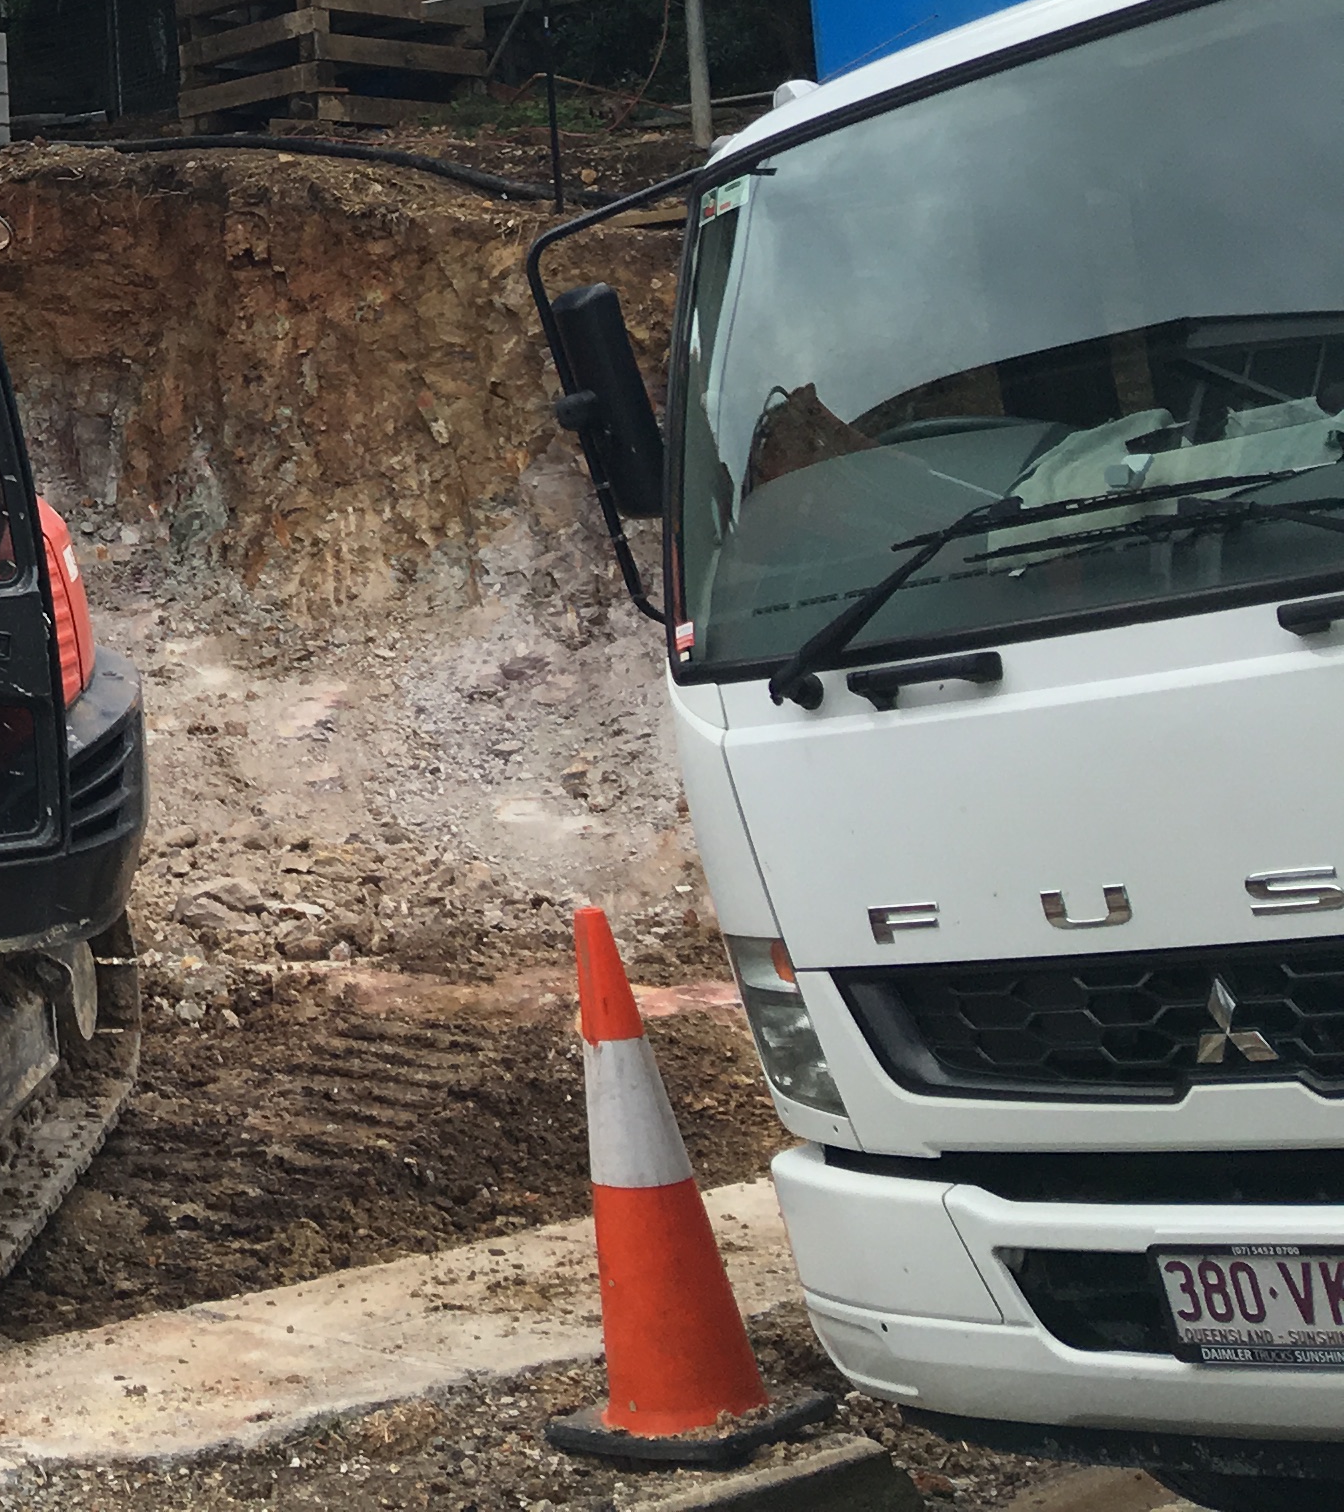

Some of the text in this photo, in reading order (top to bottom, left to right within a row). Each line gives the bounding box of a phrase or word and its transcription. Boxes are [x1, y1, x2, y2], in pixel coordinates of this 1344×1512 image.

[1231, 1246, 1250, 1256] (07)
[1276, 1246, 1300, 1255] 0700
[1185, 1328, 1273, 1345] QUEENSLAND
[1201, 1348, 1253, 1361] DAIMLER
[1254, 1350, 1293, 1363] TRUCKS
